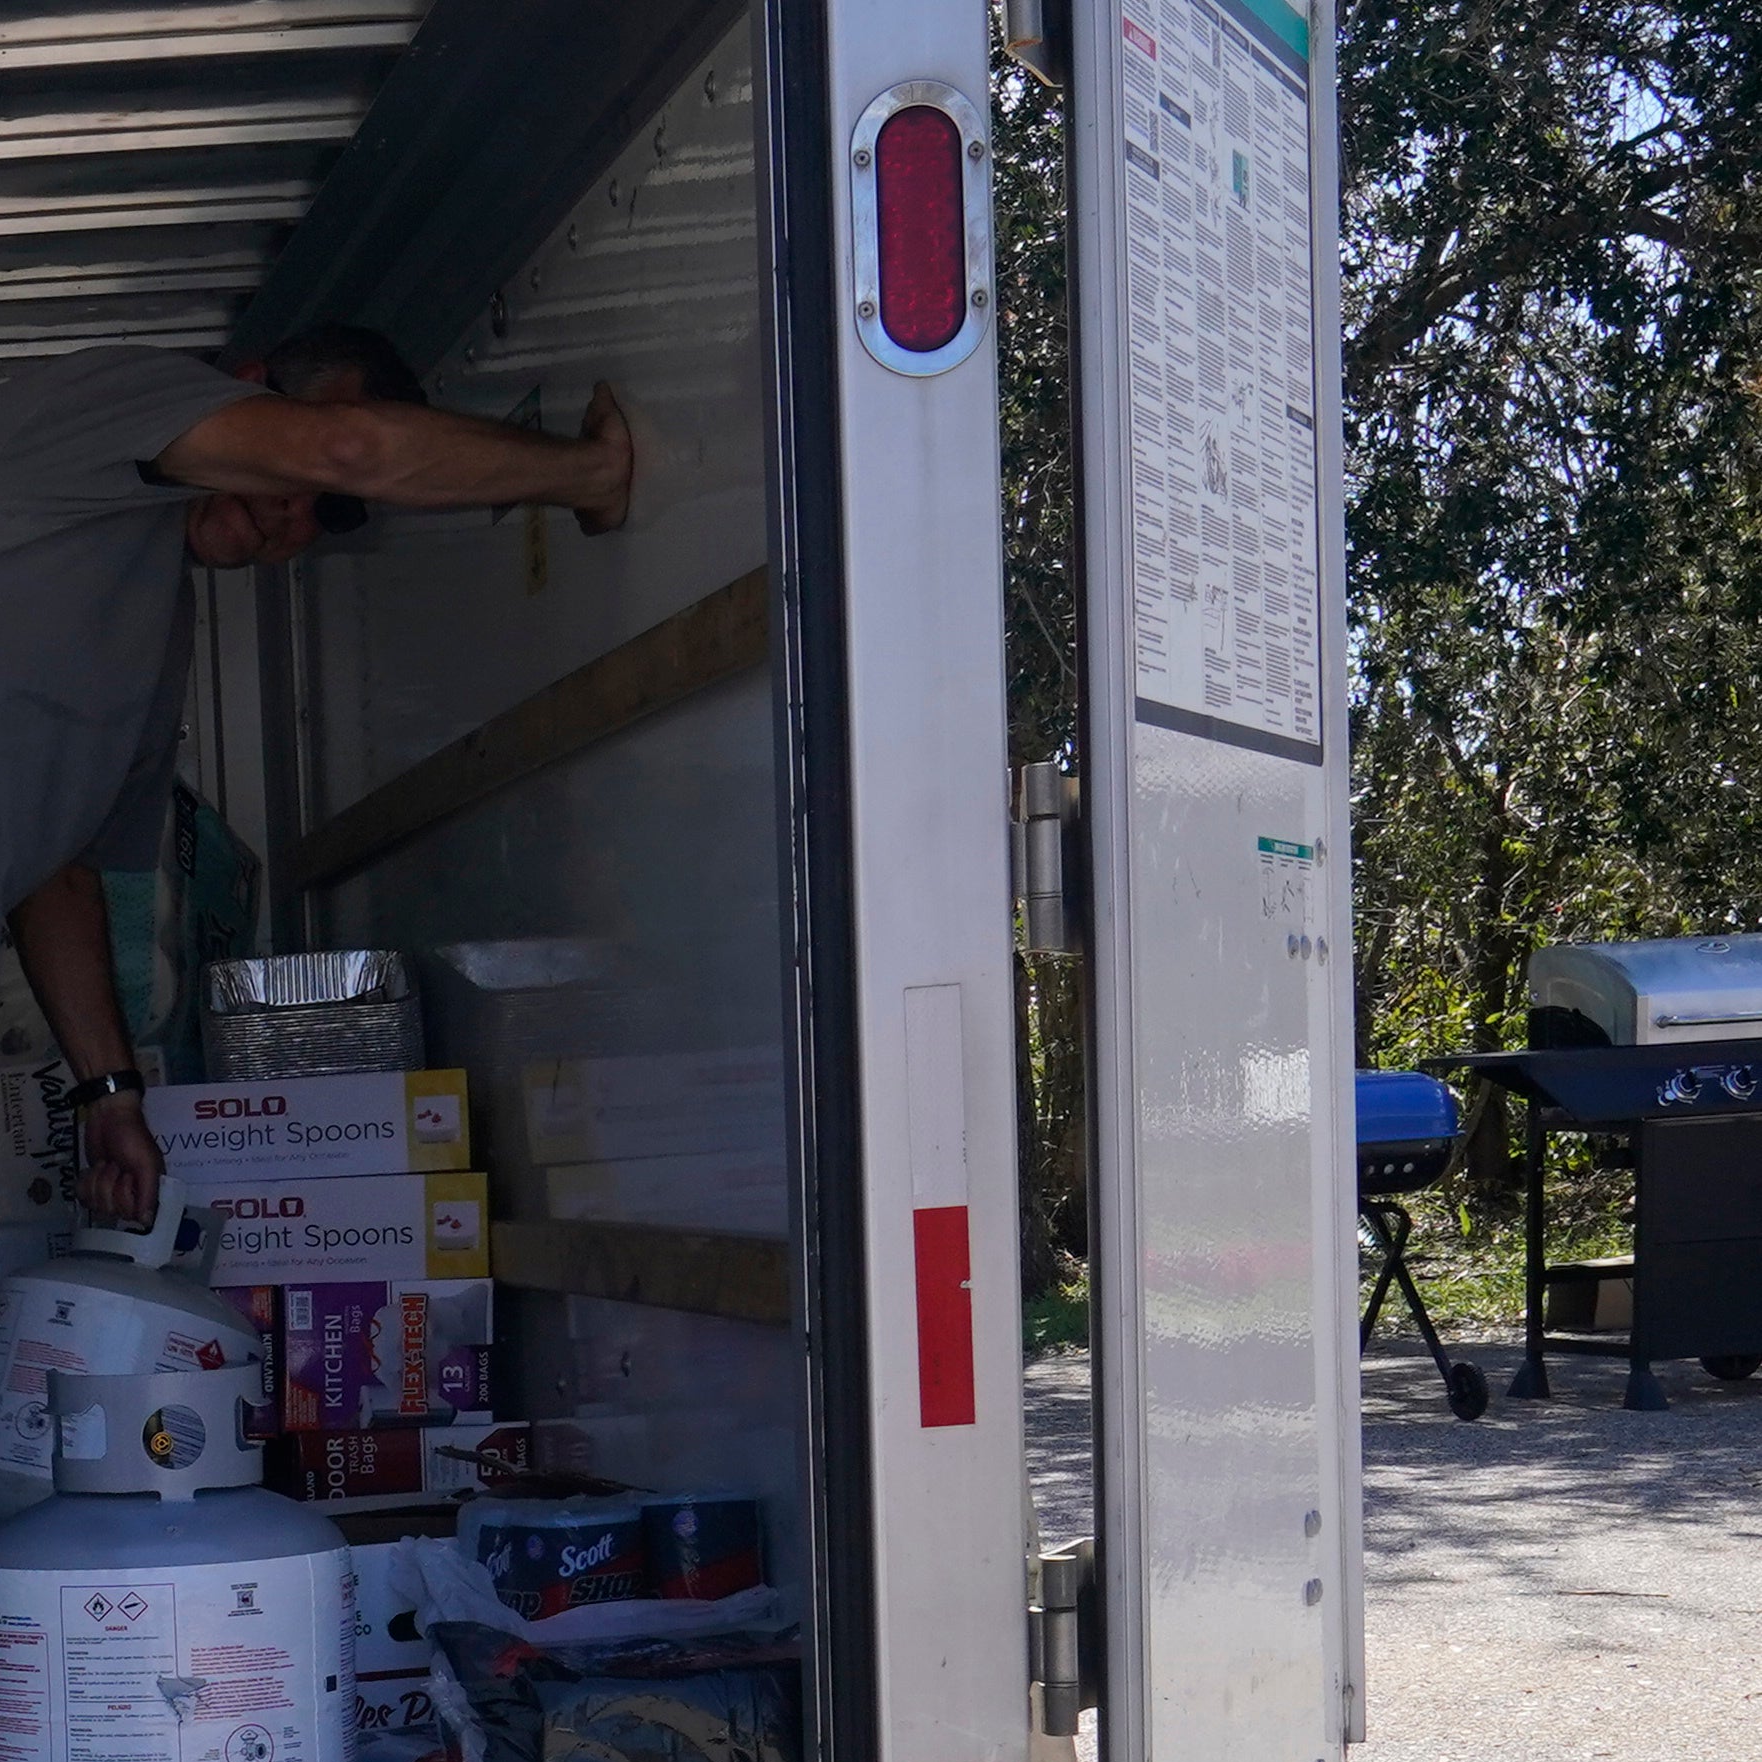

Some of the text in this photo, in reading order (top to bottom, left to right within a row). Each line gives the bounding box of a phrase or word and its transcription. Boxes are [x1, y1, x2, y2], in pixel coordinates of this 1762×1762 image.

[8, 1072, 31, 1156] Entertain
[194, 1096, 286, 1120] SOLO
[287, 1119, 395, 1149] Spoons
[210, 1197, 304, 1220] SOLO
[305, 1223, 414, 1250] Spoons
[306, 1256, 324, 1267] Any
[327, 1255, 368, 1266] Occasion
[348, 1304, 364, 1333] Bags
[263, 1333, 276, 1393] KIRKLAND
[325, 1313, 343, 1408] KITCHEN
[478, 1350, 489, 1403] 200 BAGS
[442, 1364, 465, 1393] 13
[348, 1436, 359, 1475] TRASH
[361, 1435, 378, 1475] Bags
[558, 1532, 616, 1577] Scott
